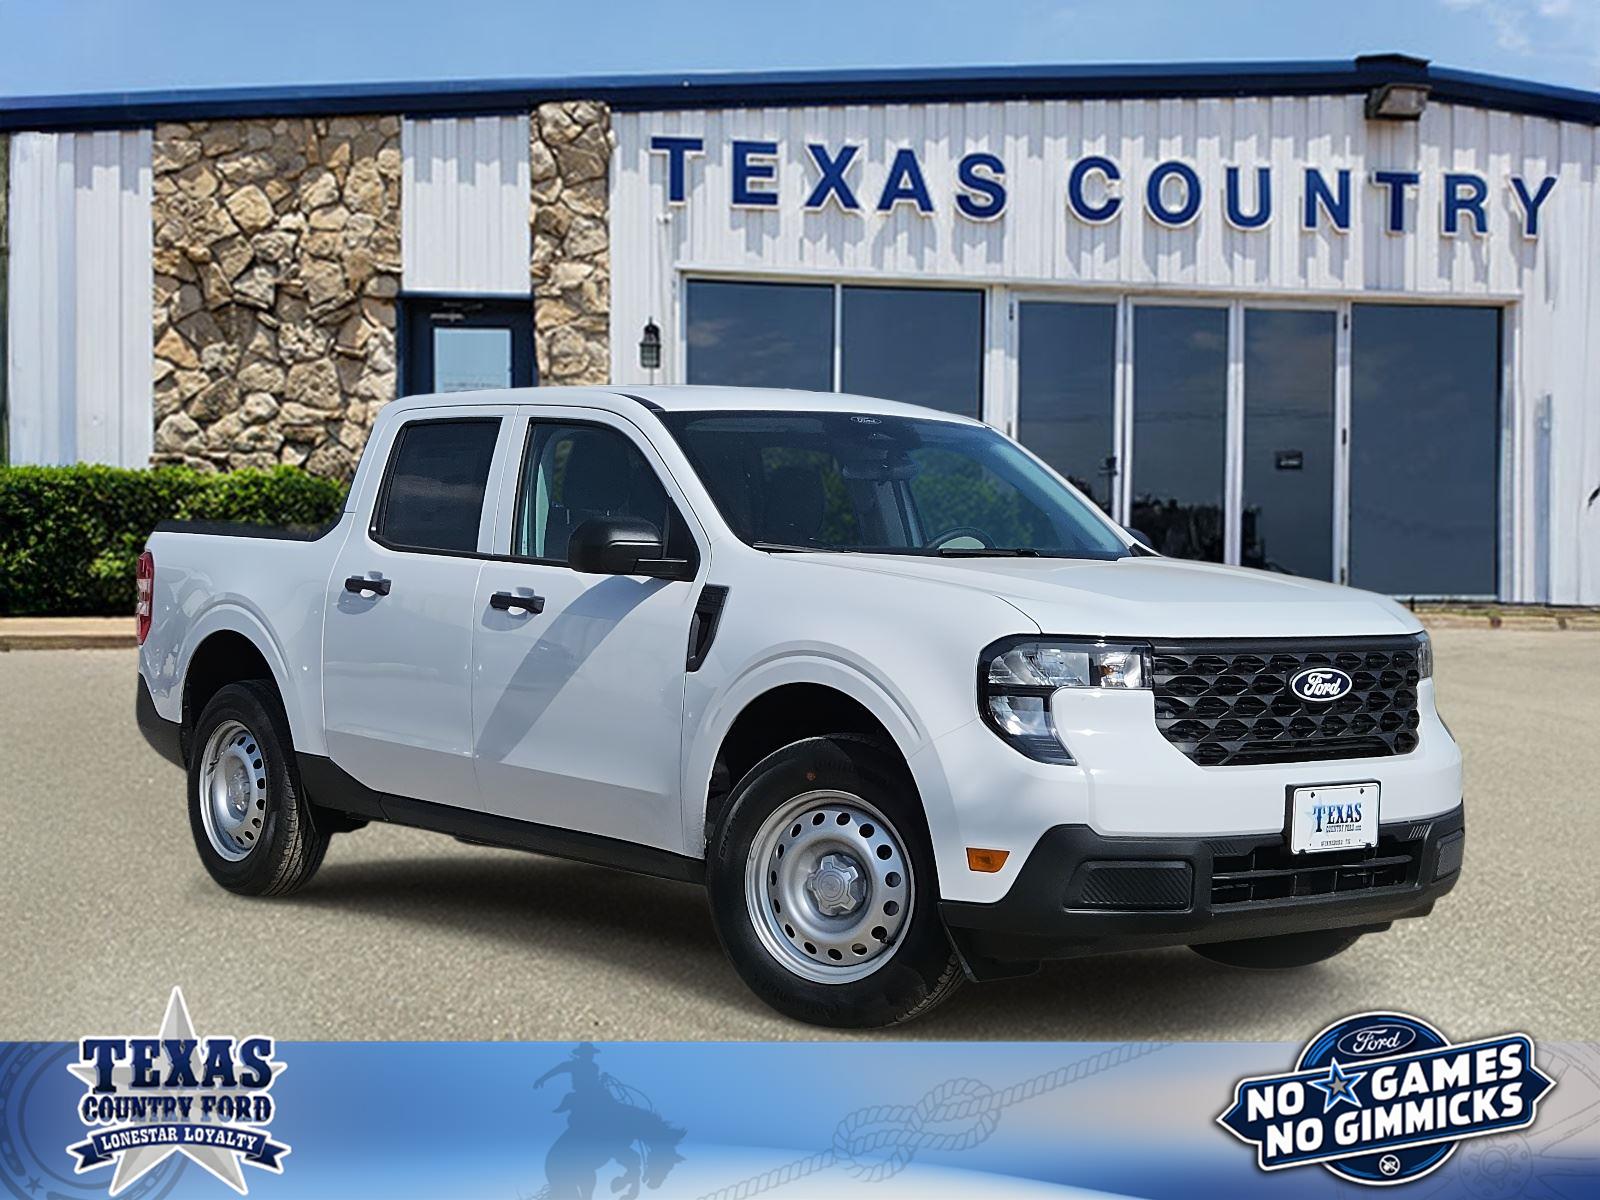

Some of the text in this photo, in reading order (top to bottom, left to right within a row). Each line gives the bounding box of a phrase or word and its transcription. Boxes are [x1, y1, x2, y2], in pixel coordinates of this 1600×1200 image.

[650, 136, 1558, 237] TEXAS COUNTRY
[1303, 672, 1342, 696] Ford
[1312, 803, 1362, 832] TEXAS
